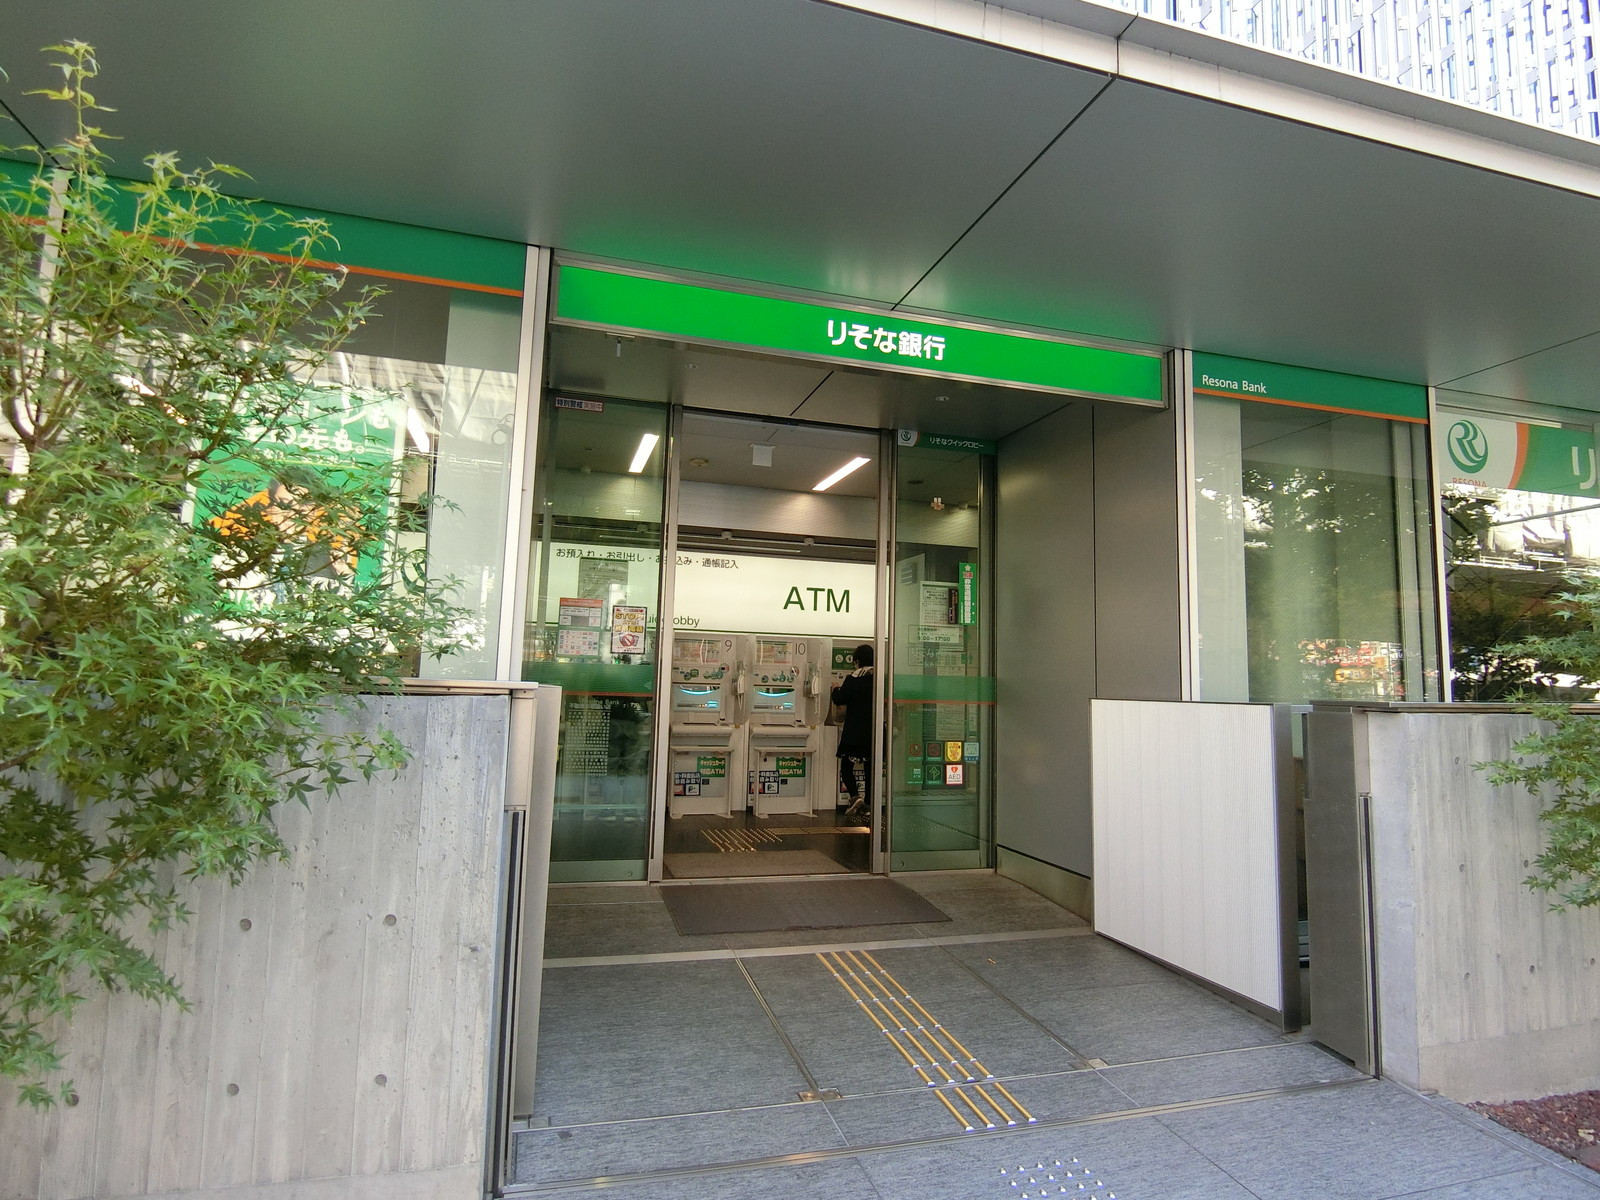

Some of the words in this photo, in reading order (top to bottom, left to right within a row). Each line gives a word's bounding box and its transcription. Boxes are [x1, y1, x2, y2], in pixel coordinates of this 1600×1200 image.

[827, 319, 946, 361] りそな銀行
[1202, 374, 1238, 389] Resona
[1242, 380, 1267, 393] Bank
[929, 436, 984, 449] りそなクイックロビー
[783, 586, 850, 613] ATM
[673, 615, 700, 628] obby
[724, 640, 733, 652] 9
[795, 643, 806, 656] 10
